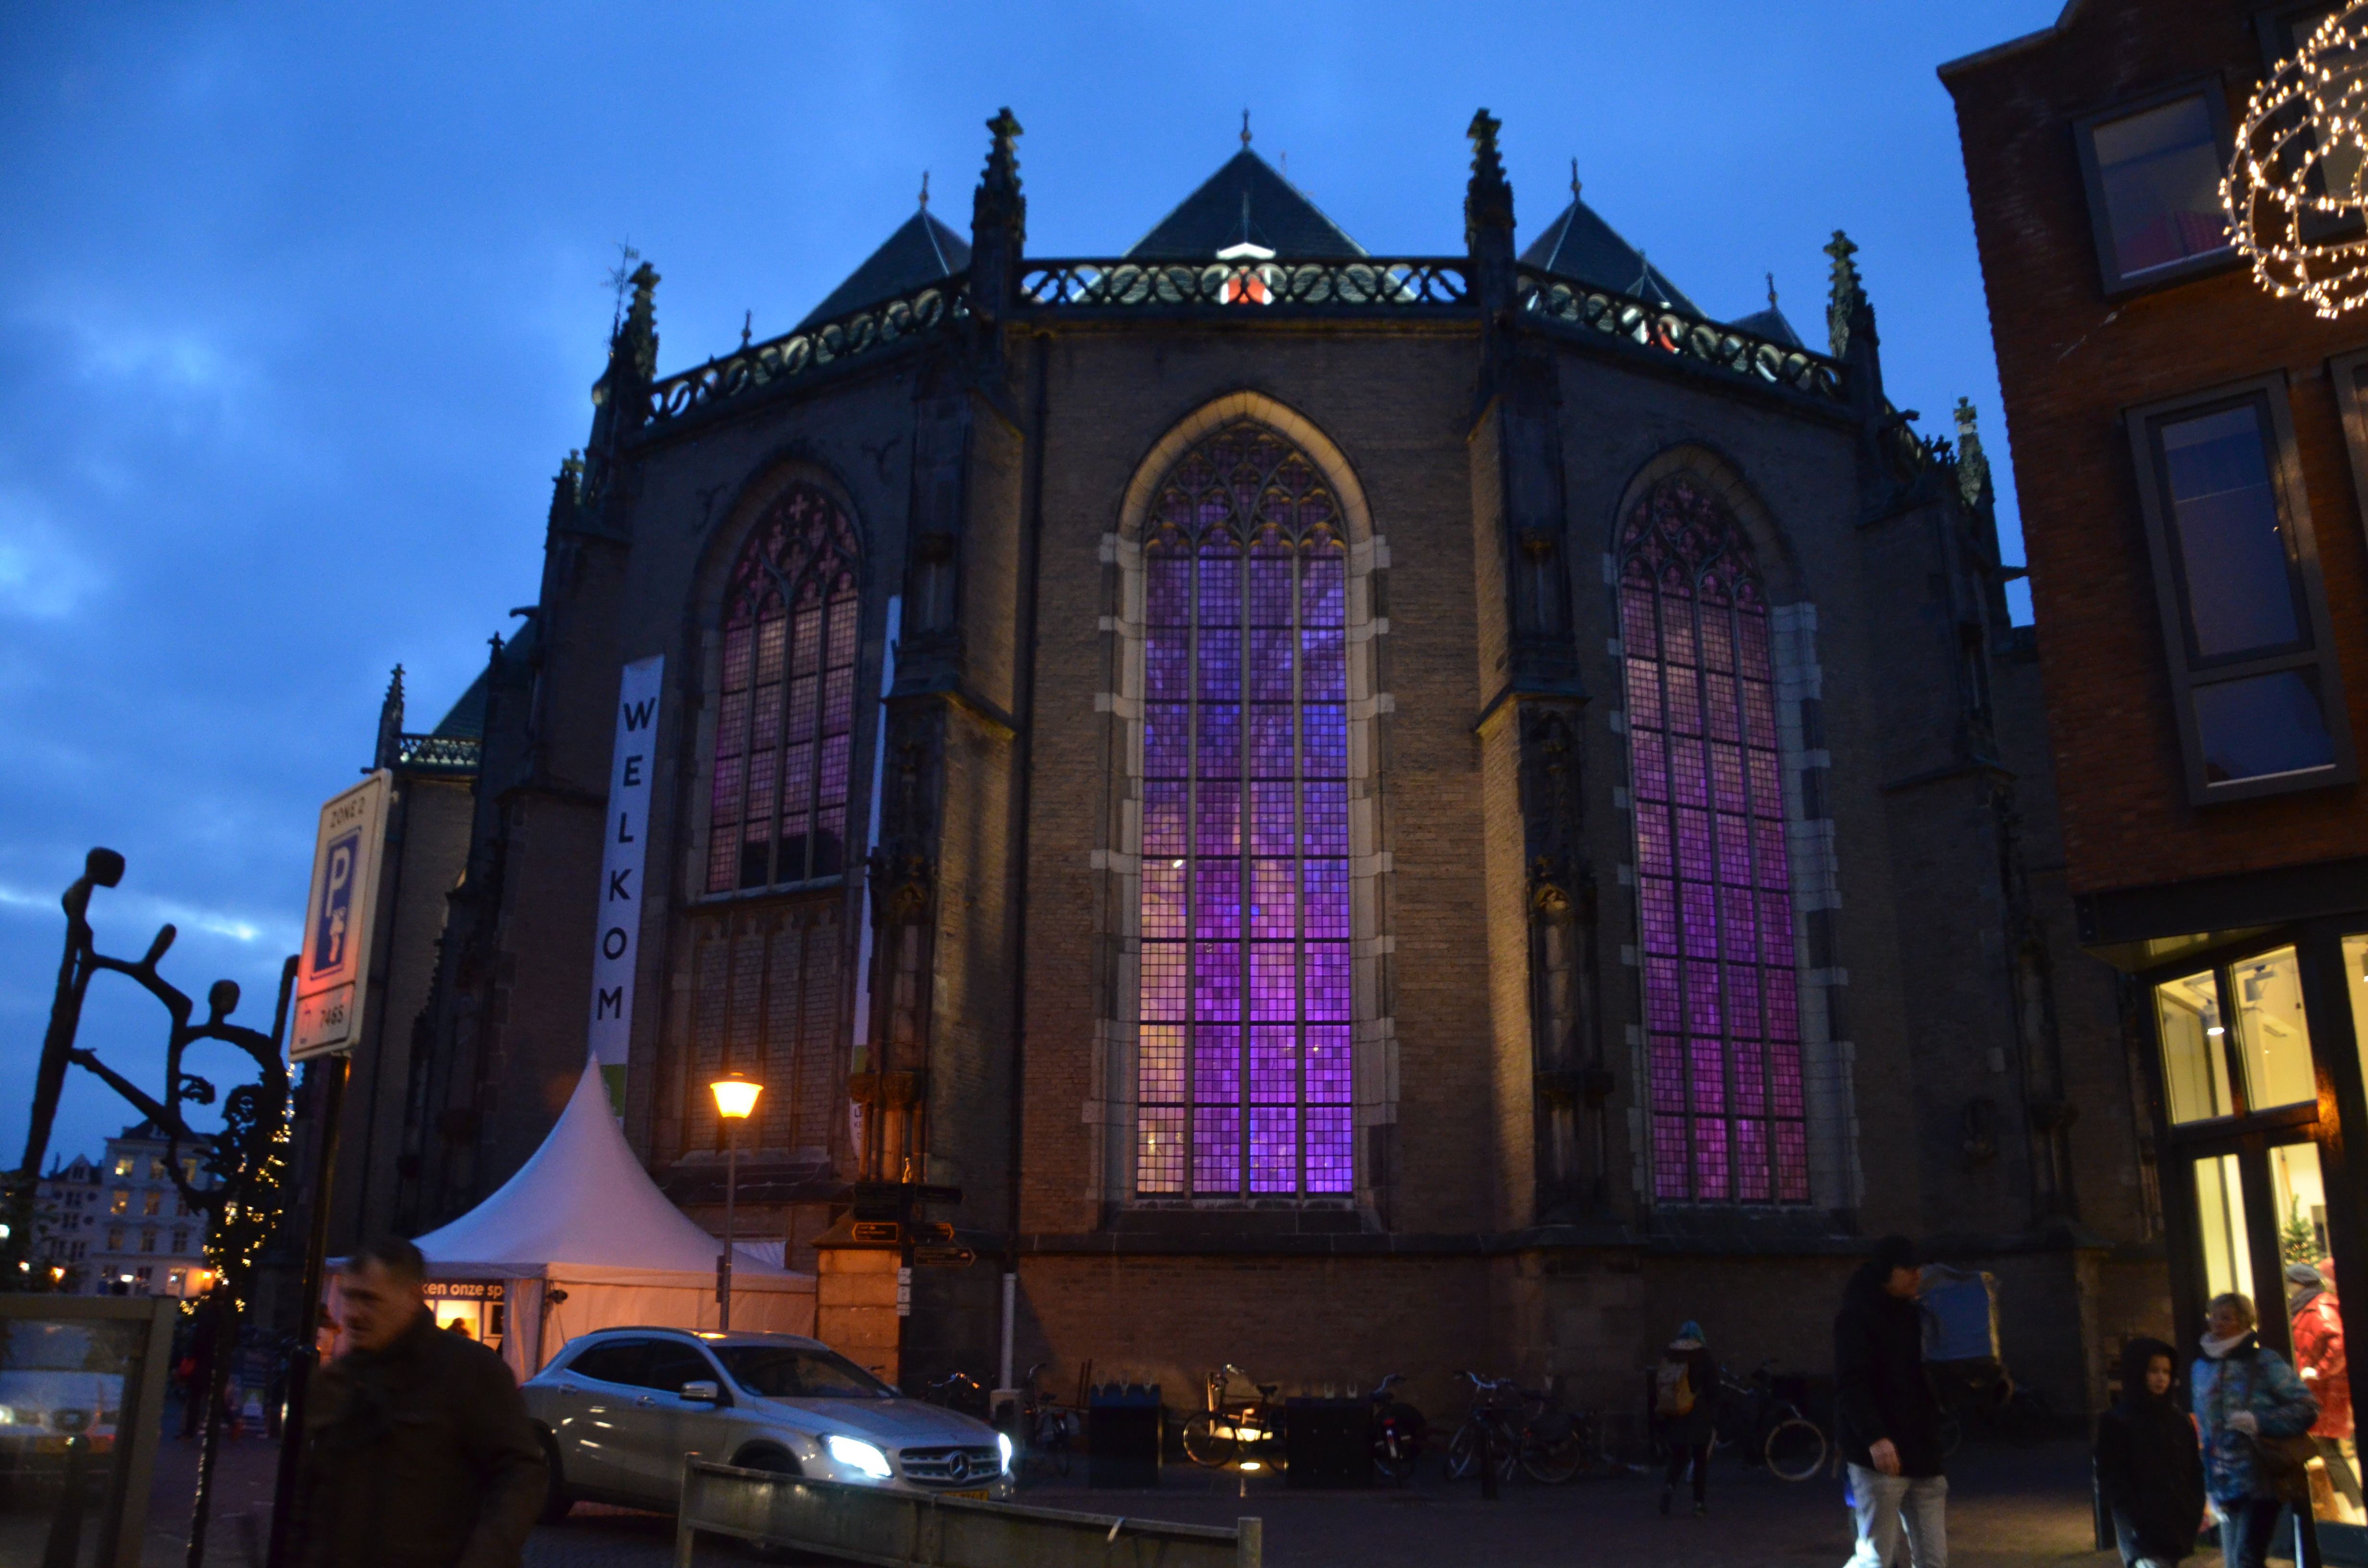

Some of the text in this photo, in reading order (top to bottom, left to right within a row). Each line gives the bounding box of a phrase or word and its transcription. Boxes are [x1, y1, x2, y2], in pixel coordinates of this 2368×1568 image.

[330, 799, 357, 828] ZONE
[325, 846, 351, 918] P
[597, 698, 655, 1019] WELKOM
[450, 1284, 485, 1296] onze
[487, 1285, 505, 1299] sp
